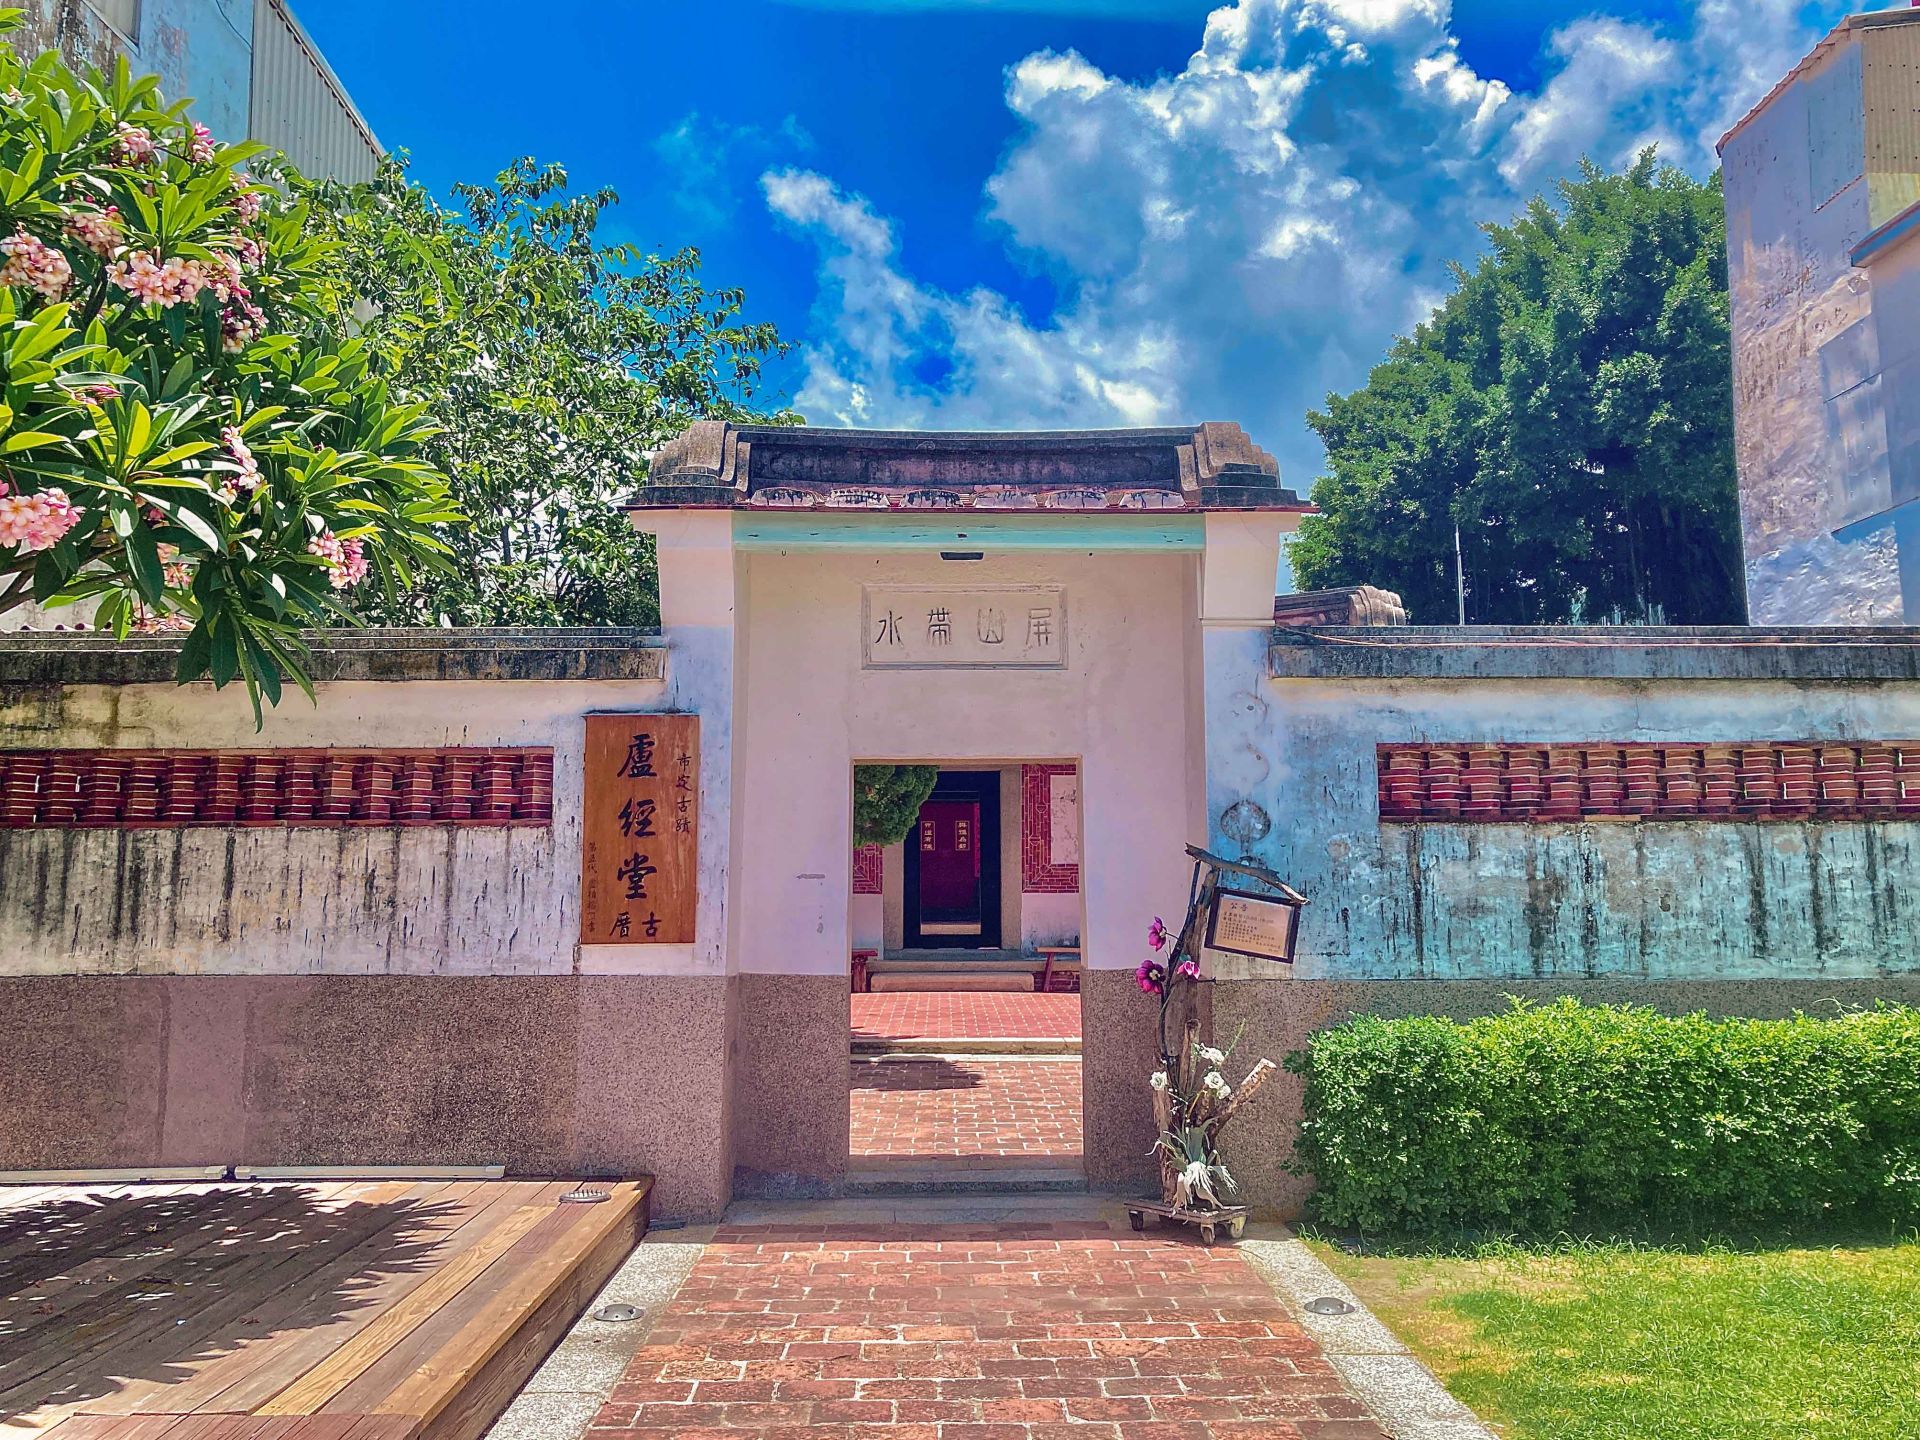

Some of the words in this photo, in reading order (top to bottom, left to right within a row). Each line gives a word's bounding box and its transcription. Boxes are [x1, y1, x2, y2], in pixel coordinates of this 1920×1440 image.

[617, 733, 657, 900] 盧經堂
[676, 752, 692, 834] 市定古蹟
